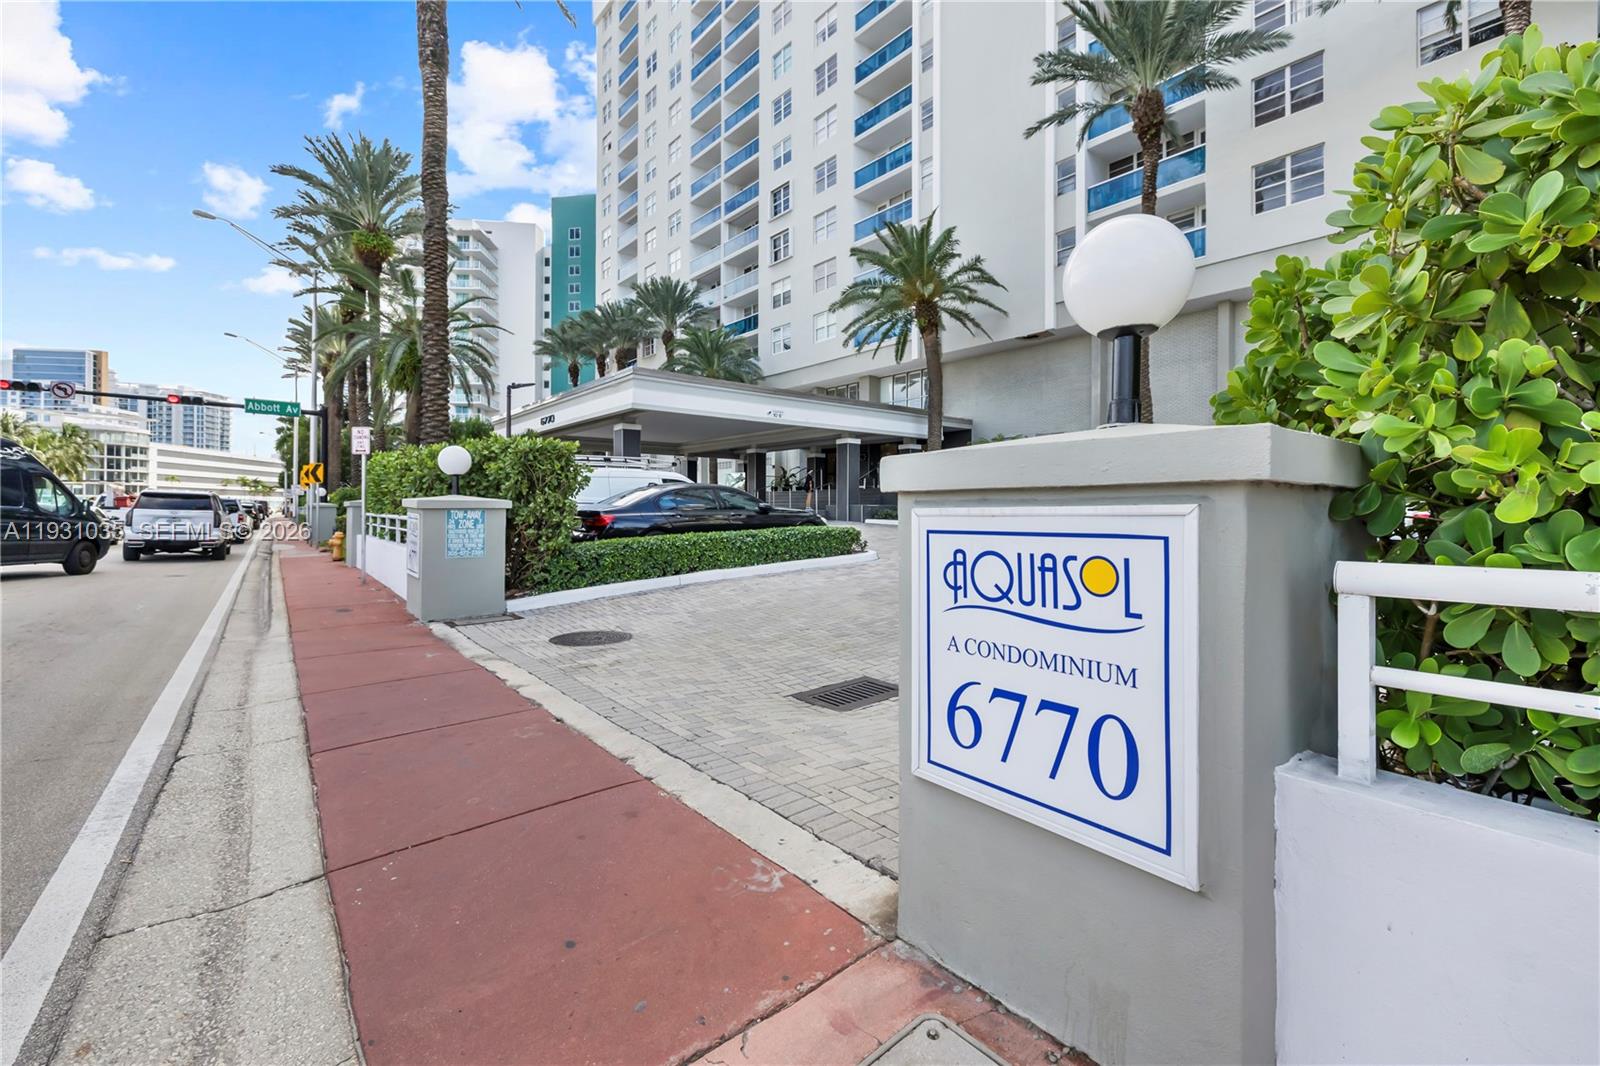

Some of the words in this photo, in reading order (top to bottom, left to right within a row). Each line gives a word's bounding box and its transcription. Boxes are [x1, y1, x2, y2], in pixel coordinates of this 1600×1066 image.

[247, 401, 280, 412] Abbott
[286, 405, 298, 413] Av
[540, 414, 555, 425] 6770
[458, 519, 475, 529] ZONE
[943, 549, 1143, 620] AQUASOL
[947, 636, 960, 653] A
[964, 638, 1139, 690] CONDOMINIUM
[946, 681, 1140, 801] 6770
